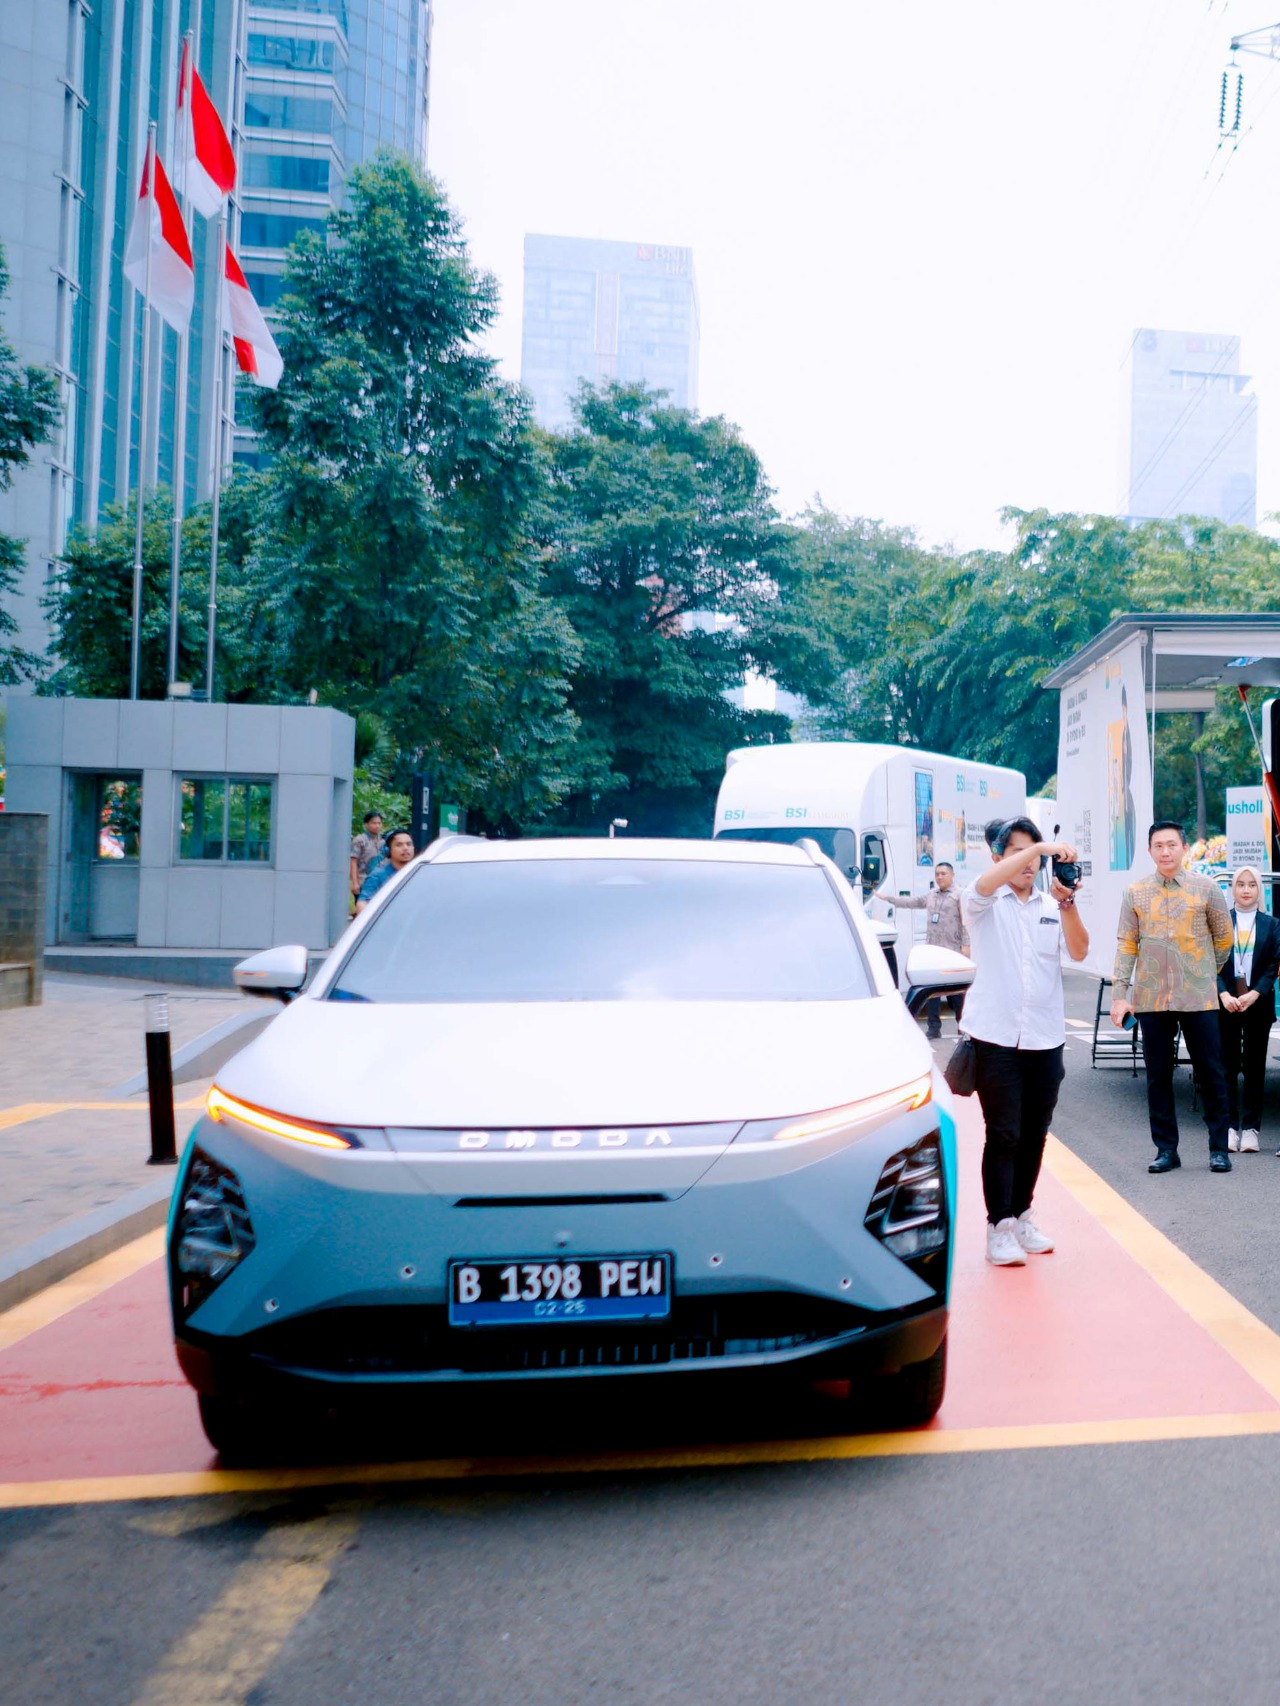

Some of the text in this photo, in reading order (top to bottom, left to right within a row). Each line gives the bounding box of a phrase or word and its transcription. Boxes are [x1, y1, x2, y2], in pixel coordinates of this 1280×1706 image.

[724, 810, 746, 821] BSI
[785, 808, 808, 819] BSI
[459, 1130, 673, 1149] OMODA
[458, 1260, 662, 1304] B 1398 PEW
